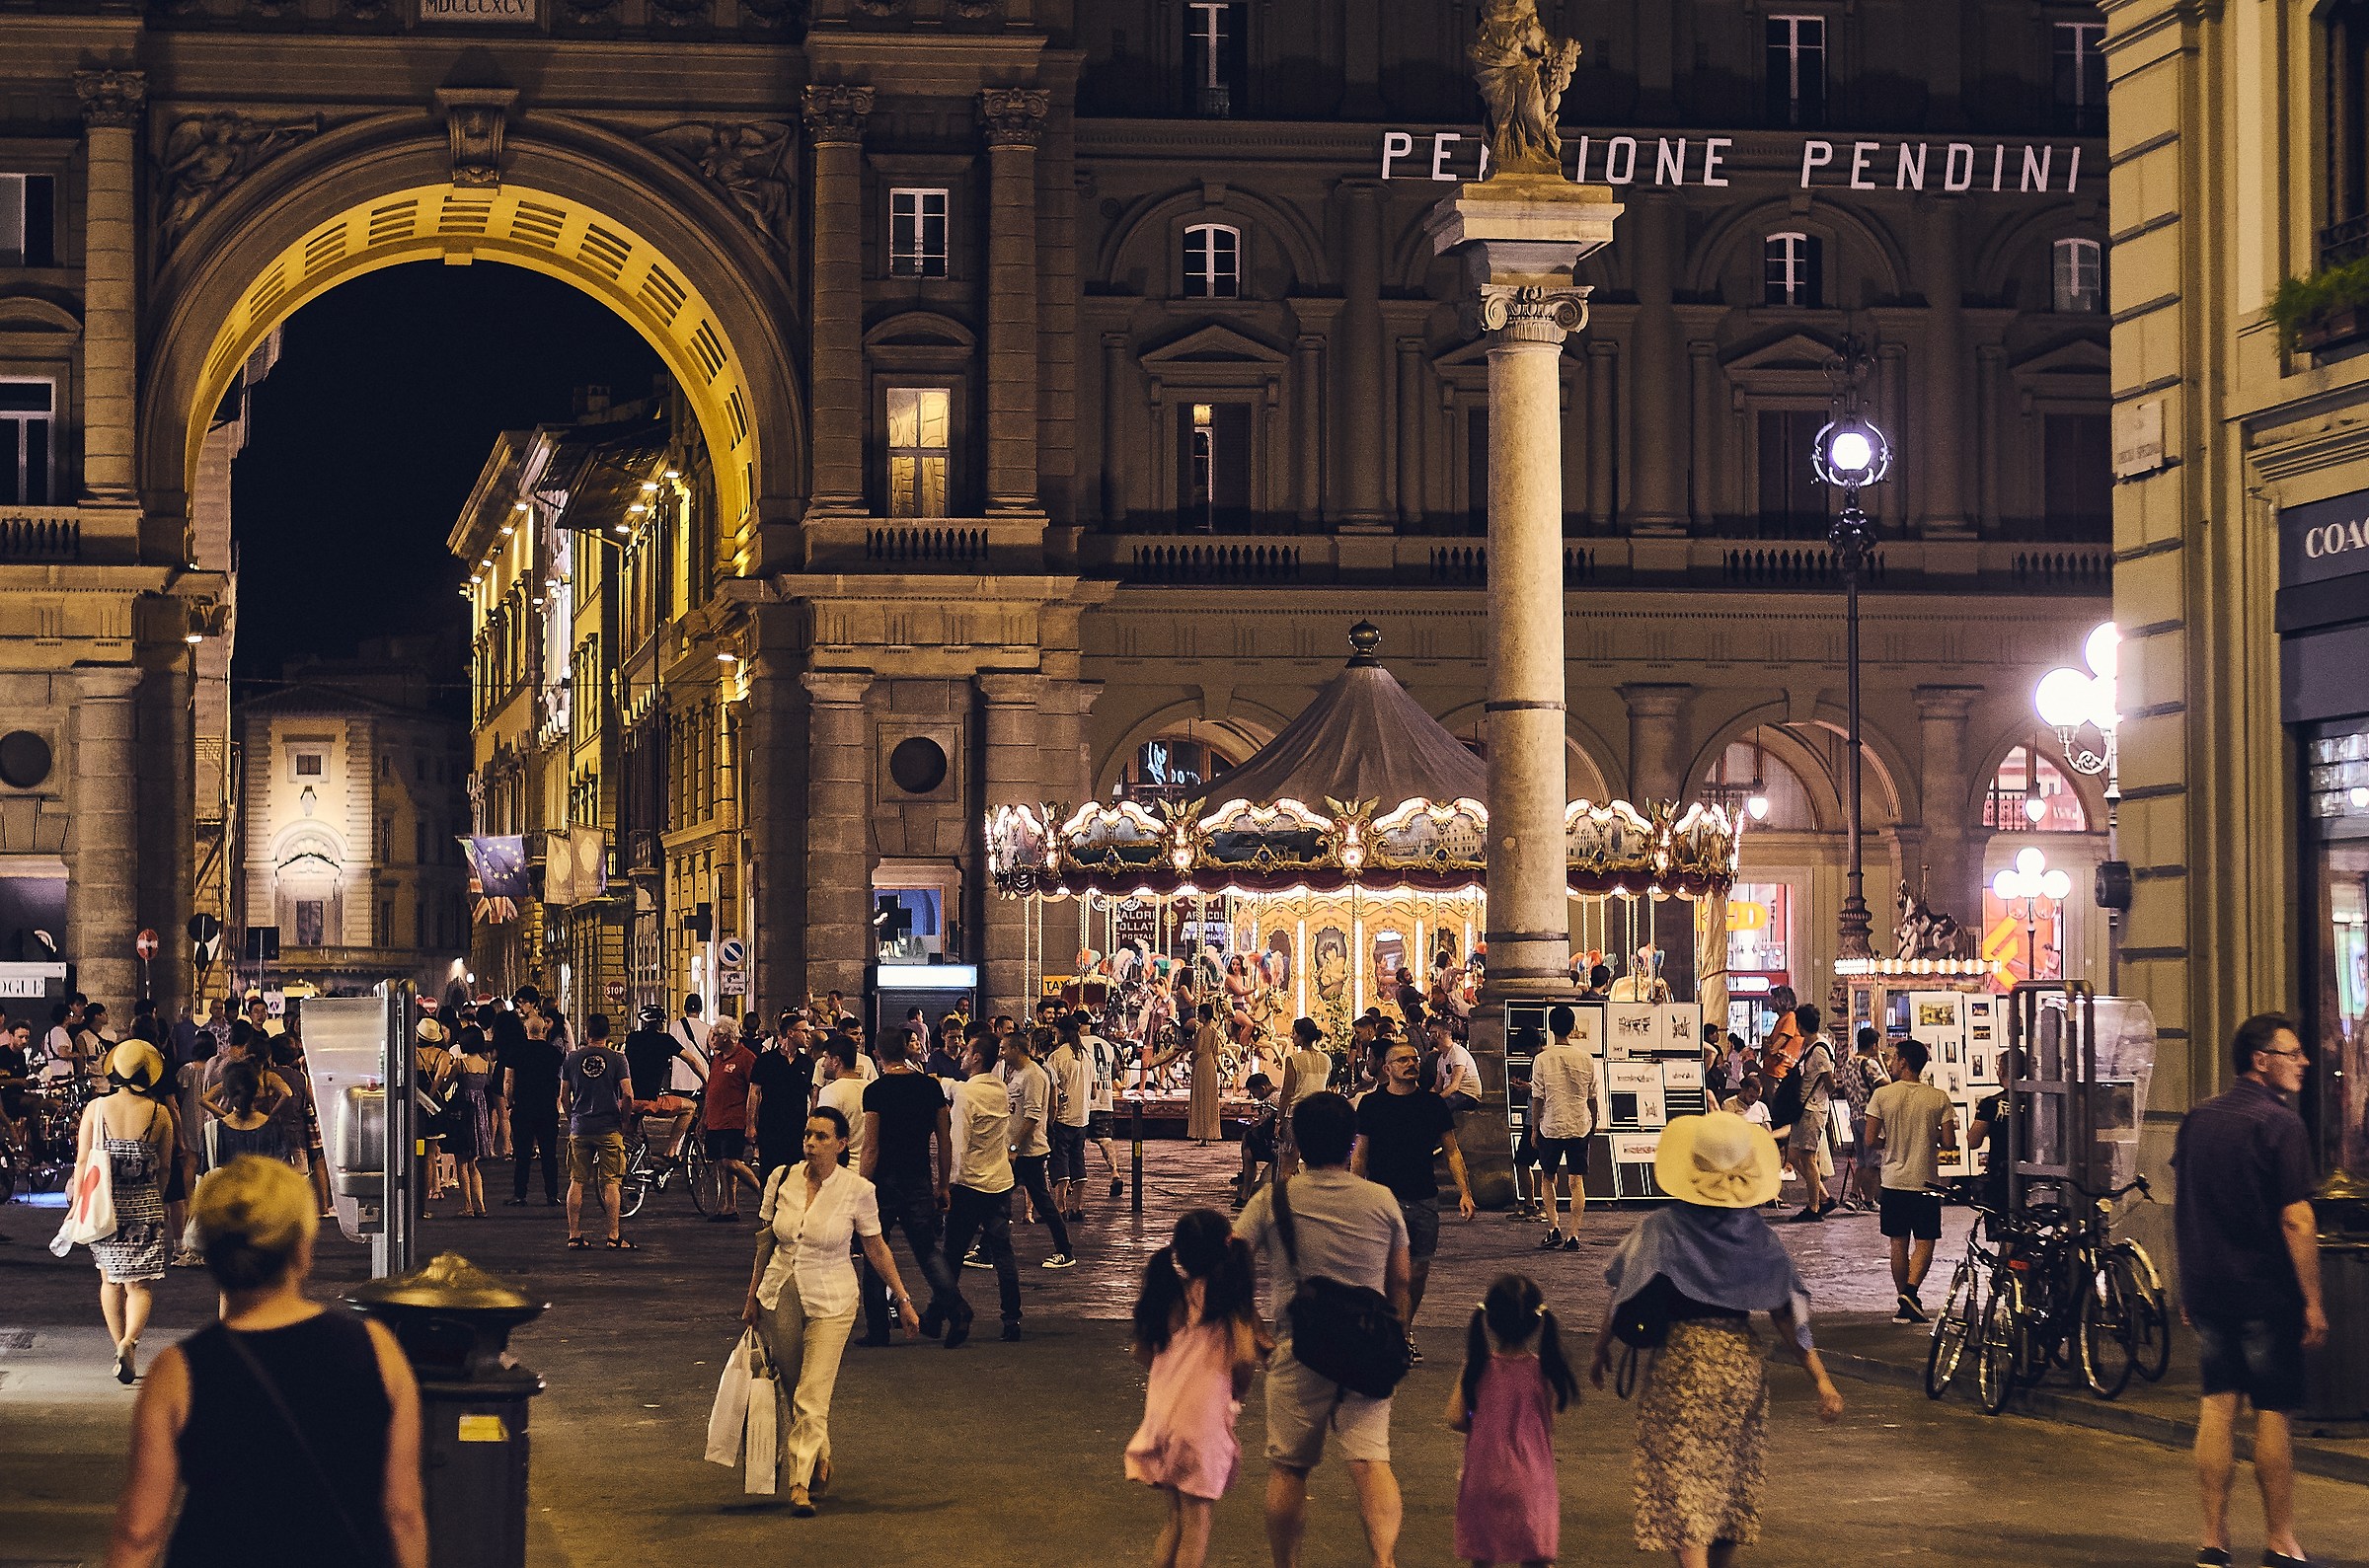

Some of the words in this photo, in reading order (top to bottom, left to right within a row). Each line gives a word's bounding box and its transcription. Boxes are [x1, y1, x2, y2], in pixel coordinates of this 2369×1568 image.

[1382, 132, 1731, 187] PEIONE
[1800, 140, 2080, 192] PENDINI
[1119, 922, 1155, 932] OLLAT
[1045, 980, 1069, 991] TAX
[606, 987, 624, 996] STOP
